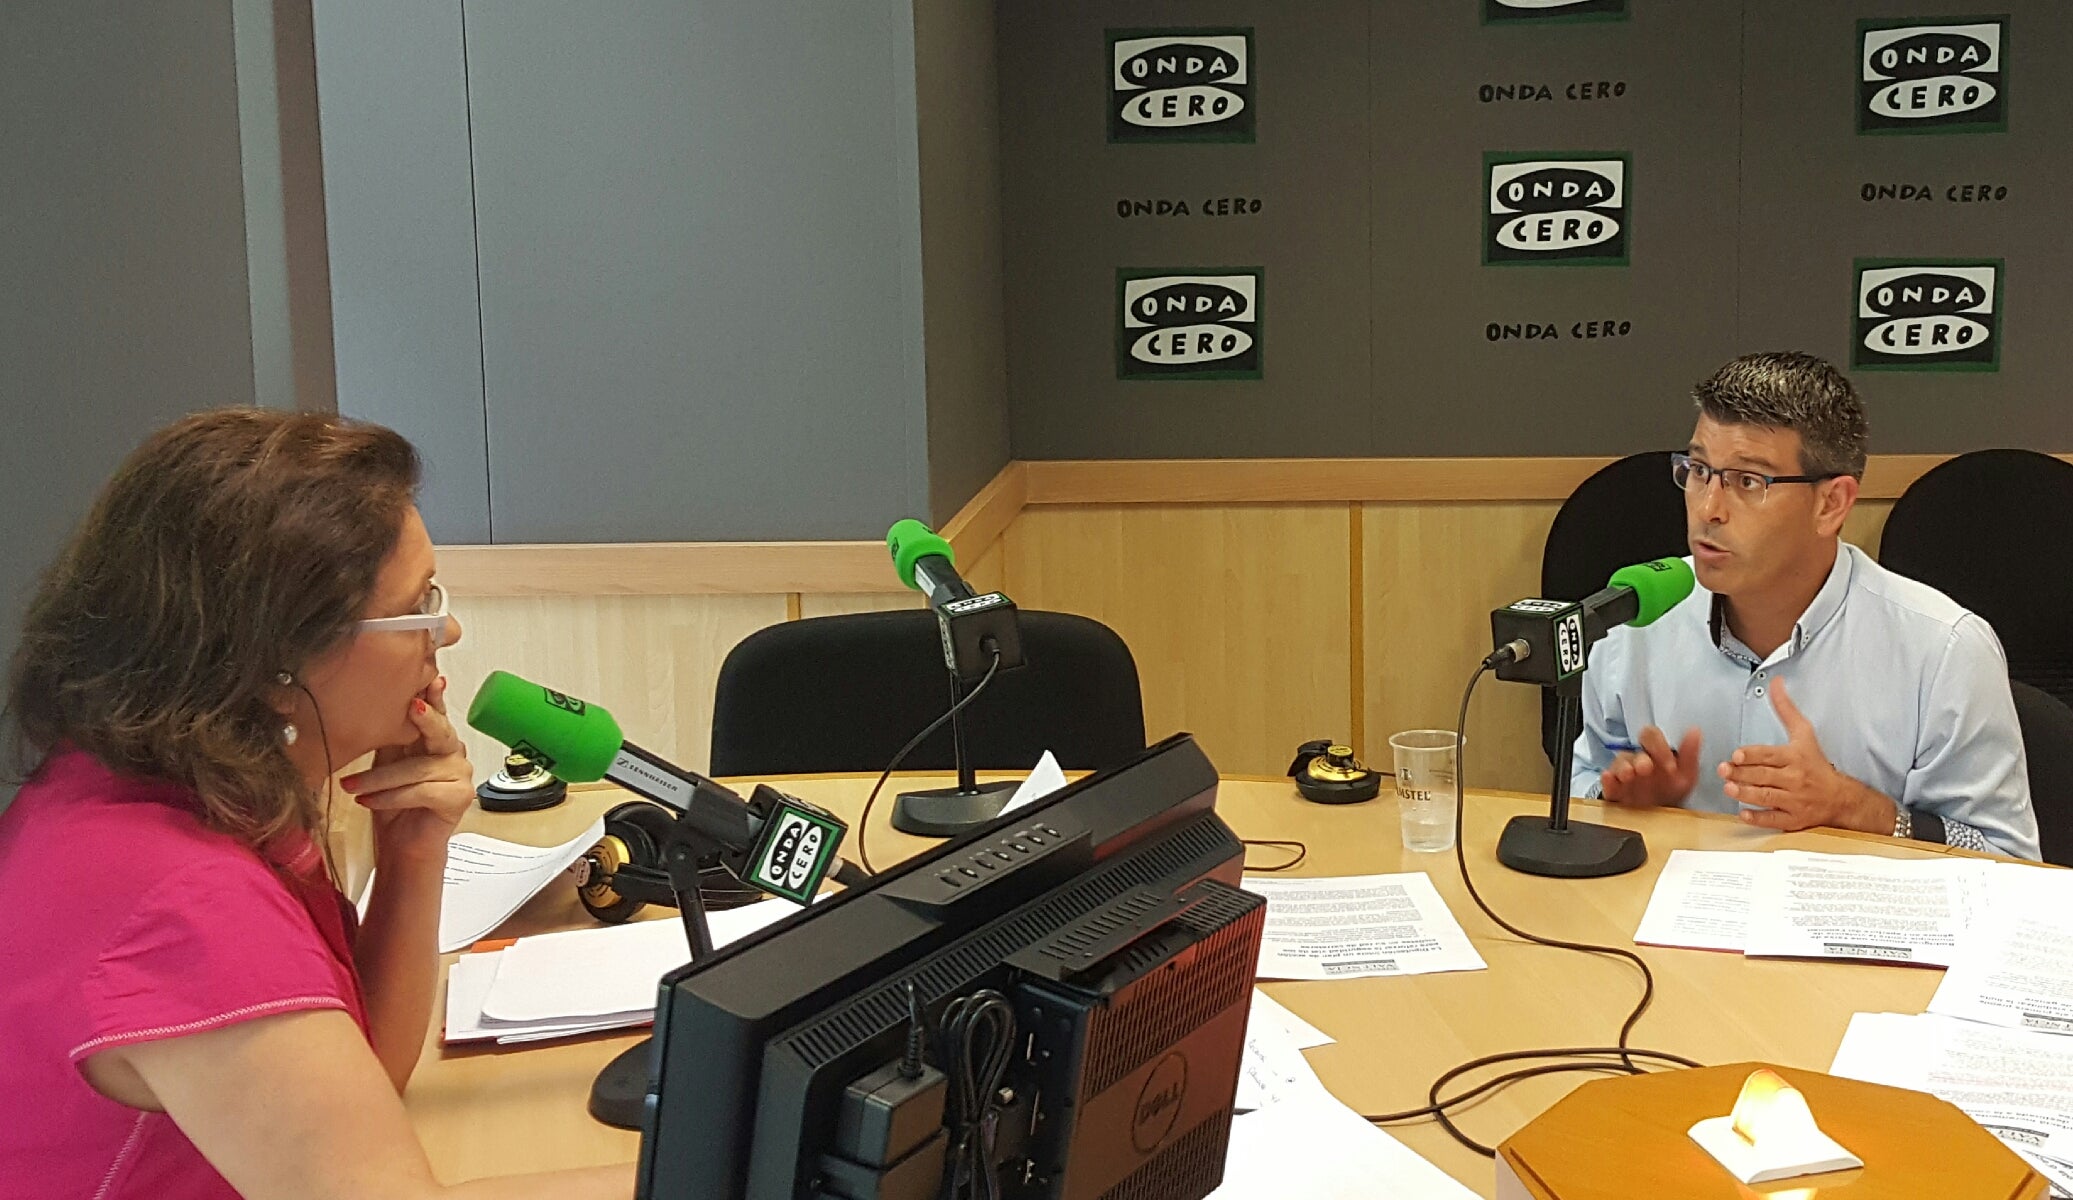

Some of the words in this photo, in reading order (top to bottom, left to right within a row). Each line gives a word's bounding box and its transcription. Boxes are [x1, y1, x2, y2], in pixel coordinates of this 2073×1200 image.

[1132, 56, 1228, 78] ONDA
[1882, 46, 1978, 69] ONDA
[1479, 84, 1553, 103] ONDA
[1565, 81, 1627, 101] CERO
[1887, 85, 1979, 110] CERO
[1137, 95, 1229, 119] CERO
[1508, 181, 1603, 202] ONDA
[1861, 182, 1933, 202] ONDA
[1946, 185, 2008, 203] CERO
[1117, 198, 1190, 218] ONDA
[1202, 197, 1262, 217] CERO
[1513, 219, 1604, 243] CERO
[1141, 296, 1236, 316] ONDA
[1878, 287, 1974, 306] ONDA
[1486, 323, 1559, 342] ONDA
[1571, 320, 1631, 339] CERO
[1881, 324, 1973, 347] CERO
[1147, 333, 1237, 357] CERO
[1569, 621, 1578, 662] ONDA
[629, 764, 679, 792] SENNHEISER
[771, 827, 800, 875] ONDA
[792, 834, 818, 880] CERO
[1139, 1082, 1179, 1127] DELL
